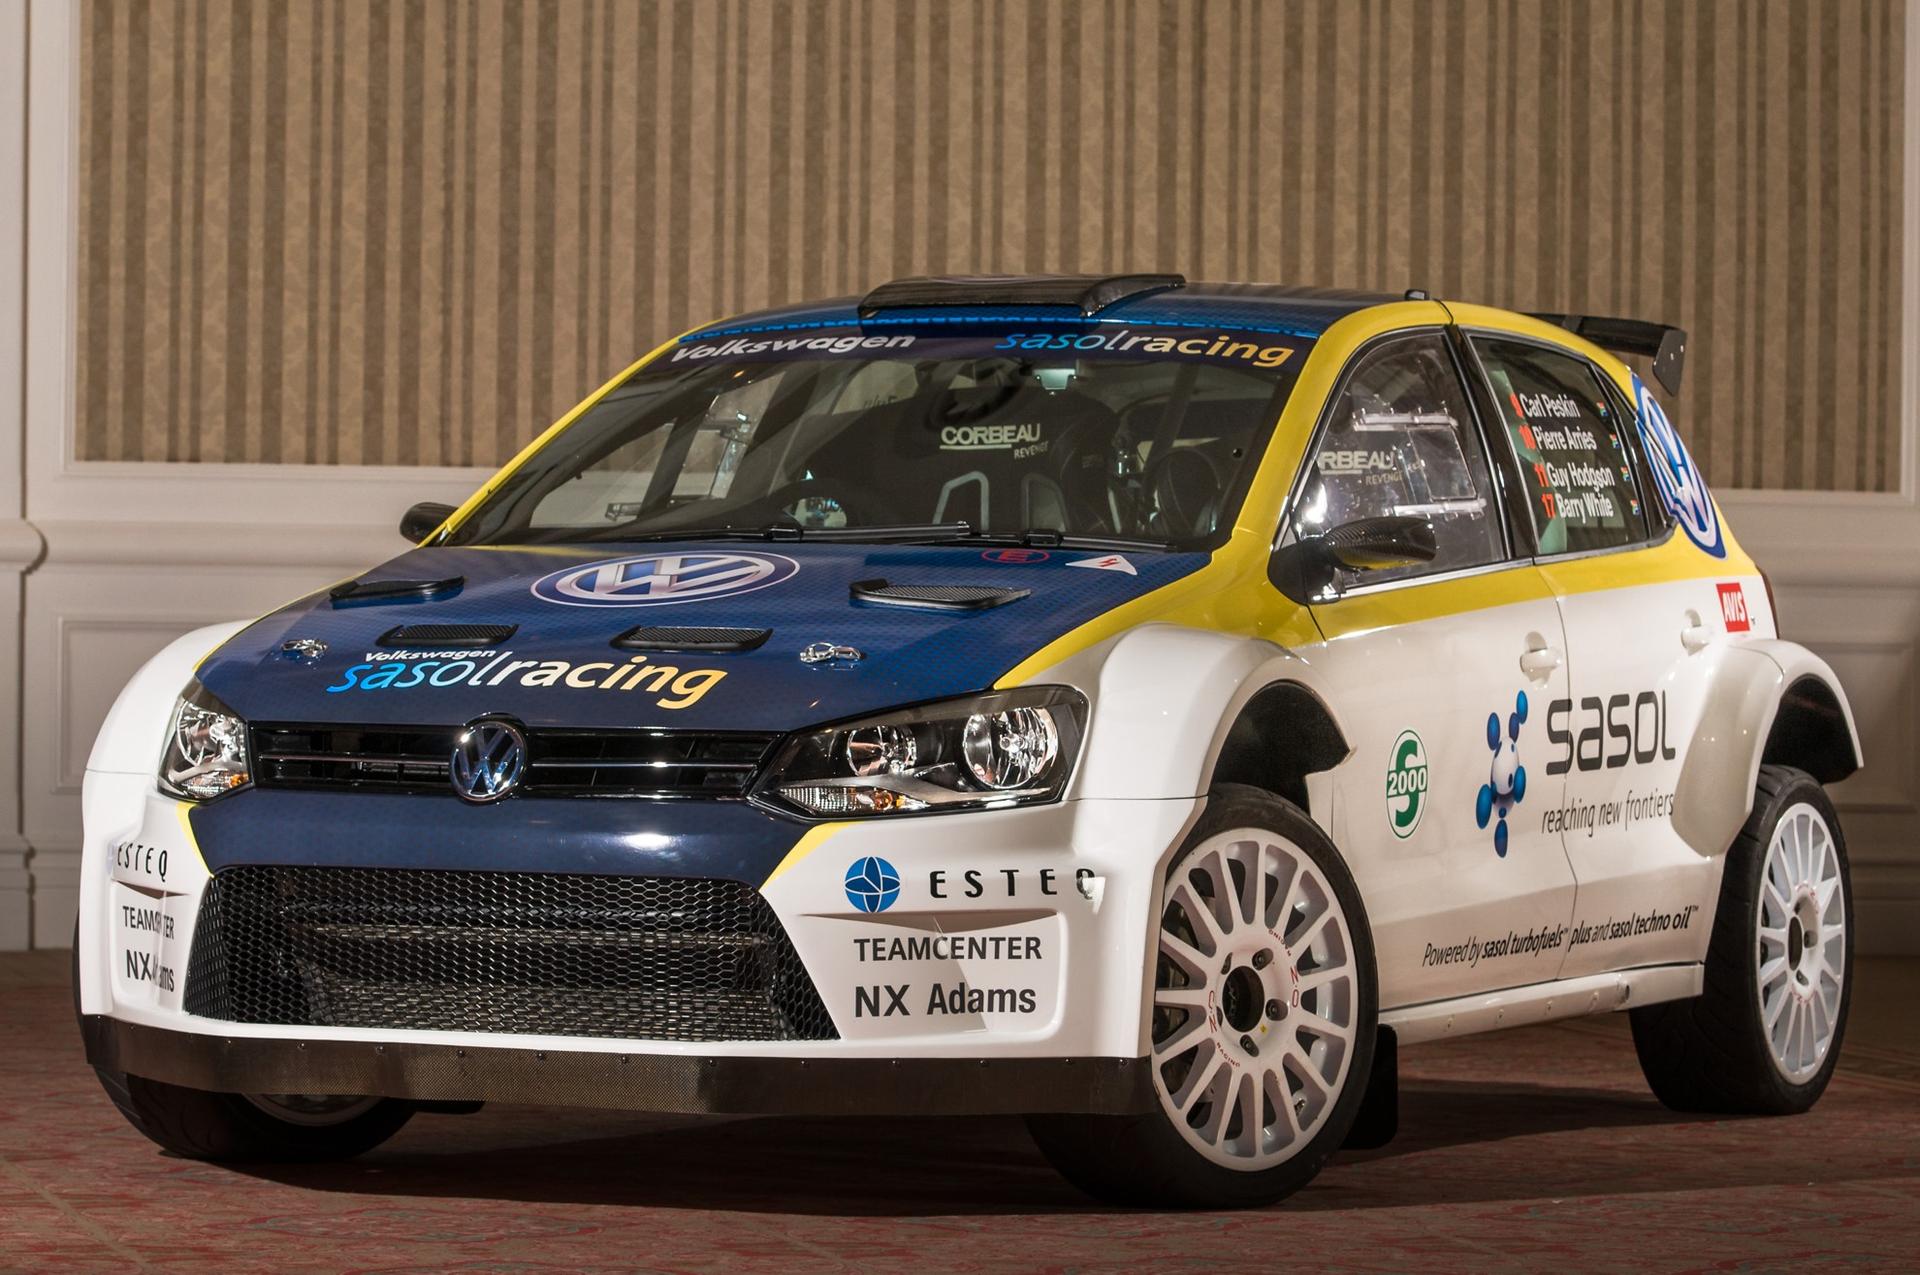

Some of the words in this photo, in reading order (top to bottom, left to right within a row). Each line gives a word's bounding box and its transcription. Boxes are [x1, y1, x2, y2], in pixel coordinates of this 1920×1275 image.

[671, 335, 916, 362] Volkswagen
[995, 330, 1295, 367] sasolracing
[1520, 393, 1546, 417] Carl
[1541, 394, 1581, 417] Peskin
[941, 423, 1040, 445] CORBEAU
[1532, 425, 1566, 450] Pierre
[1317, 450, 1395, 471] RBEAU
[1533, 463, 1549, 487] 11
[1546, 462, 1571, 493] Guy
[1568, 462, 1616, 493] Hodgson
[1541, 493, 1556, 518] 17
[1555, 493, 1586, 524] Barry
[1582, 493, 1614, 517] White
[1722, 592, 1746, 622] AVIS
[365, 650, 496, 662] Volkswagen
[326, 651, 729, 710] sasolracing
[1546, 690, 1676, 776] sasol
[1387, 767, 1427, 797] 2000
[1541, 798, 1596, 838] reaching
[1599, 801, 1622, 827] new
[1625, 788, 1675, 831] frontiers
[117, 842, 168, 882] ESTEQ
[853, 936, 1042, 961] TEAMCENTER
[1422, 936, 1471, 967] Powered
[1468, 936, 1483, 968] by
[1482, 931, 1512, 959] sasol
[1568, 920, 1592, 952] plus
[1592, 916, 1612, 942] and
[1609, 912, 1636, 939] sasol
[1634, 909, 1671, 935] techno
[126, 949, 151, 981] NX
[855, 984, 911, 1017] NX
[926, 982, 1037, 1015] Adams
